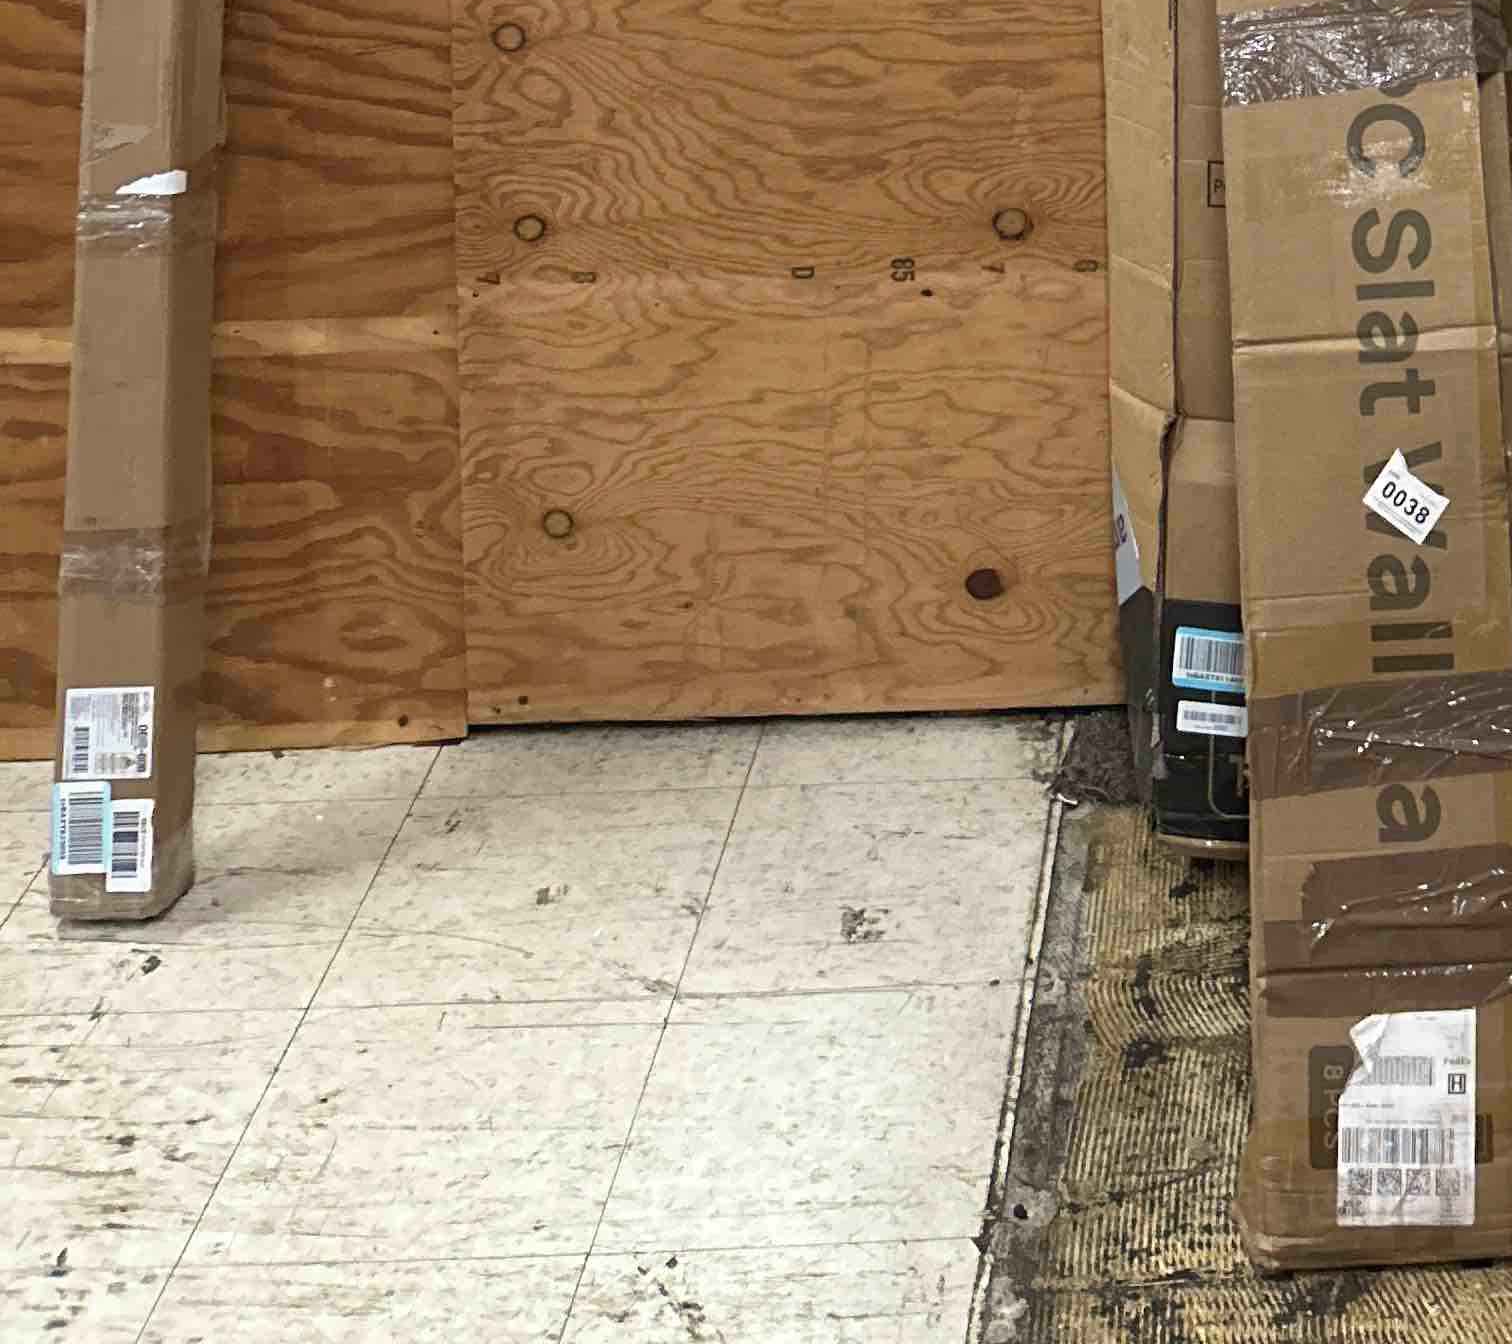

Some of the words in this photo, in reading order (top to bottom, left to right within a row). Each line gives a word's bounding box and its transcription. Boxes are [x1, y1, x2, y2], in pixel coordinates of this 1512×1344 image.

[1351, 208, 1437, 417] Slat
[1381, 480, 1430, 525] 0038
[1322, 1064, 1345, 1081] 8
